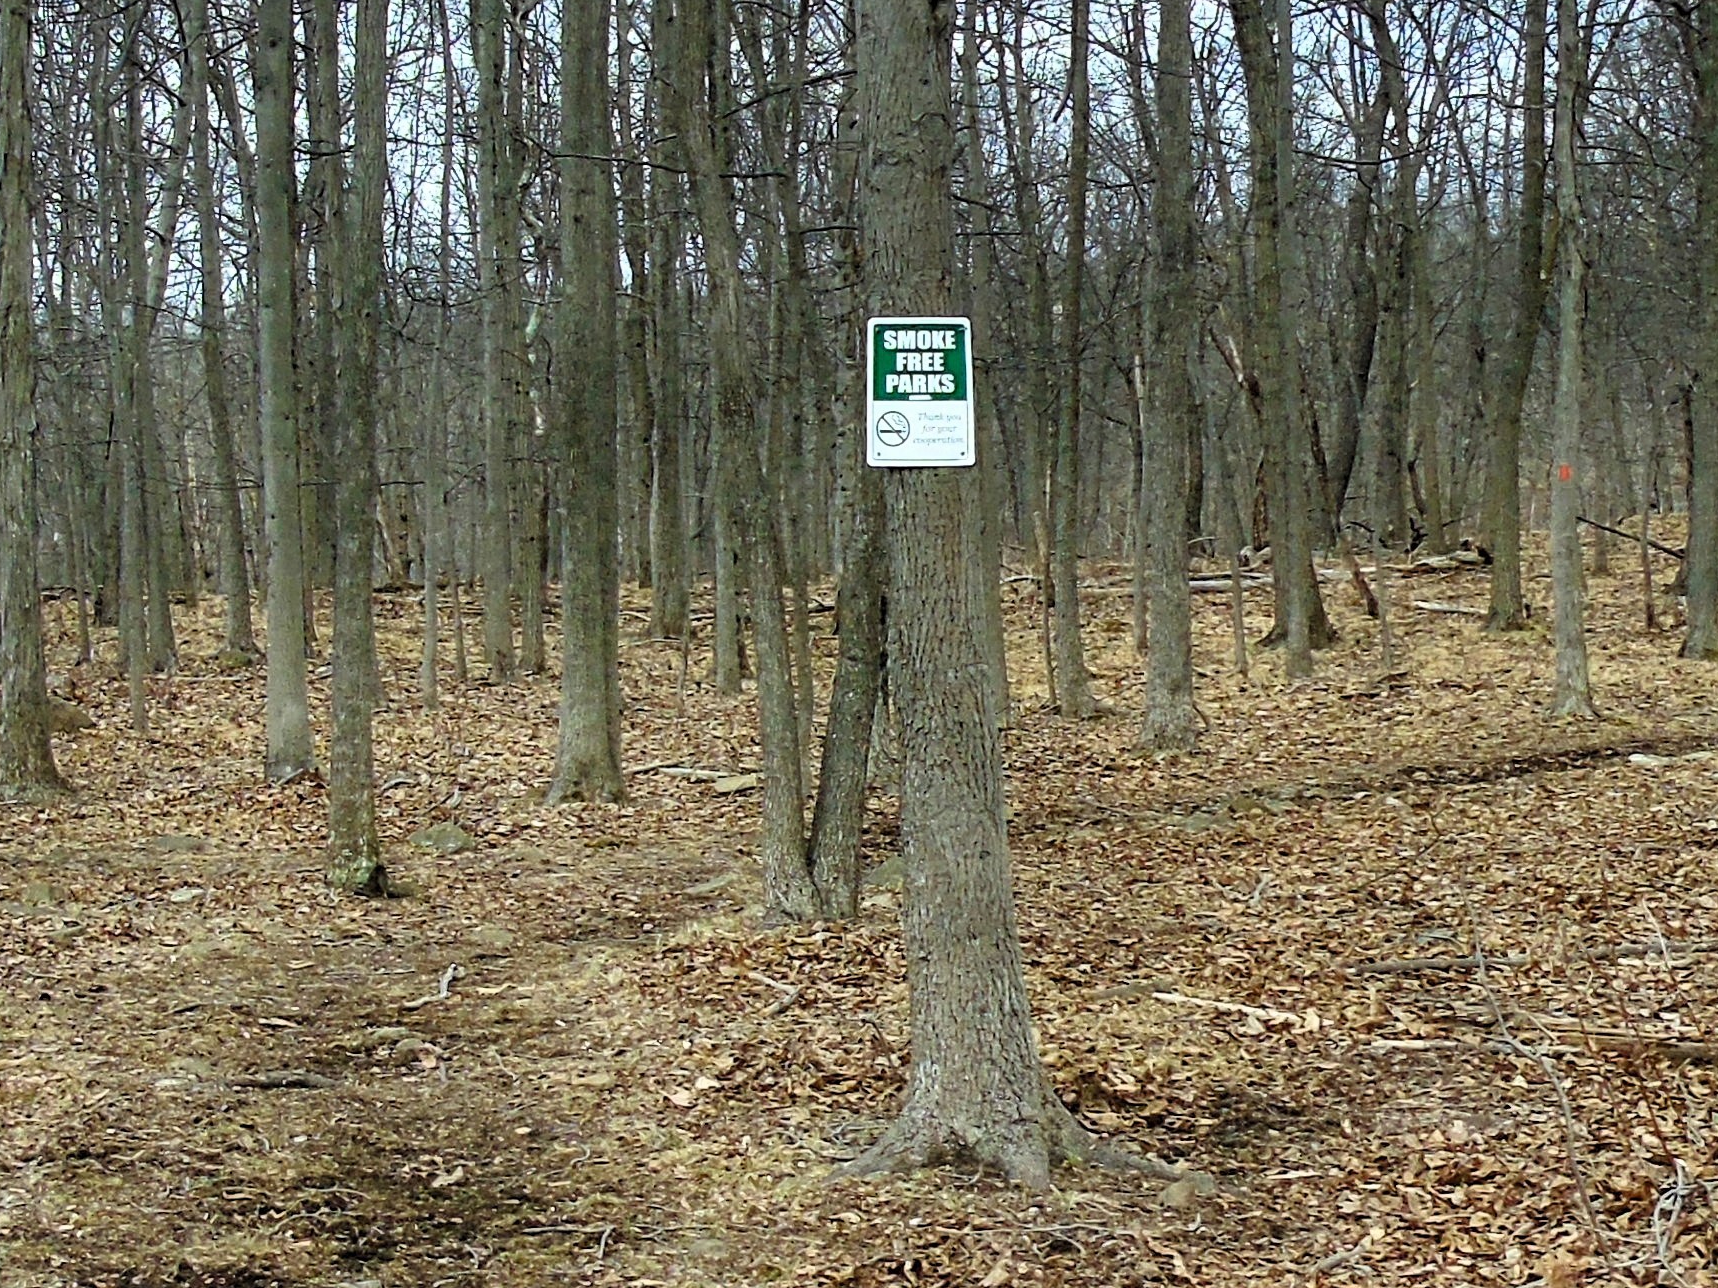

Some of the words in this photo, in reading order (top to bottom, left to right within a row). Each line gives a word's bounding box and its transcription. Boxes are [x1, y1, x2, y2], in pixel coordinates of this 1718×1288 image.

[883, 330, 956, 350] SMOKE
[896, 352, 944, 371] FREE
[885, 374, 955, 393] PARKS
[918, 412, 942, 421] Thank
[946, 415, 961, 423] you
[921, 424, 935, 434] for
